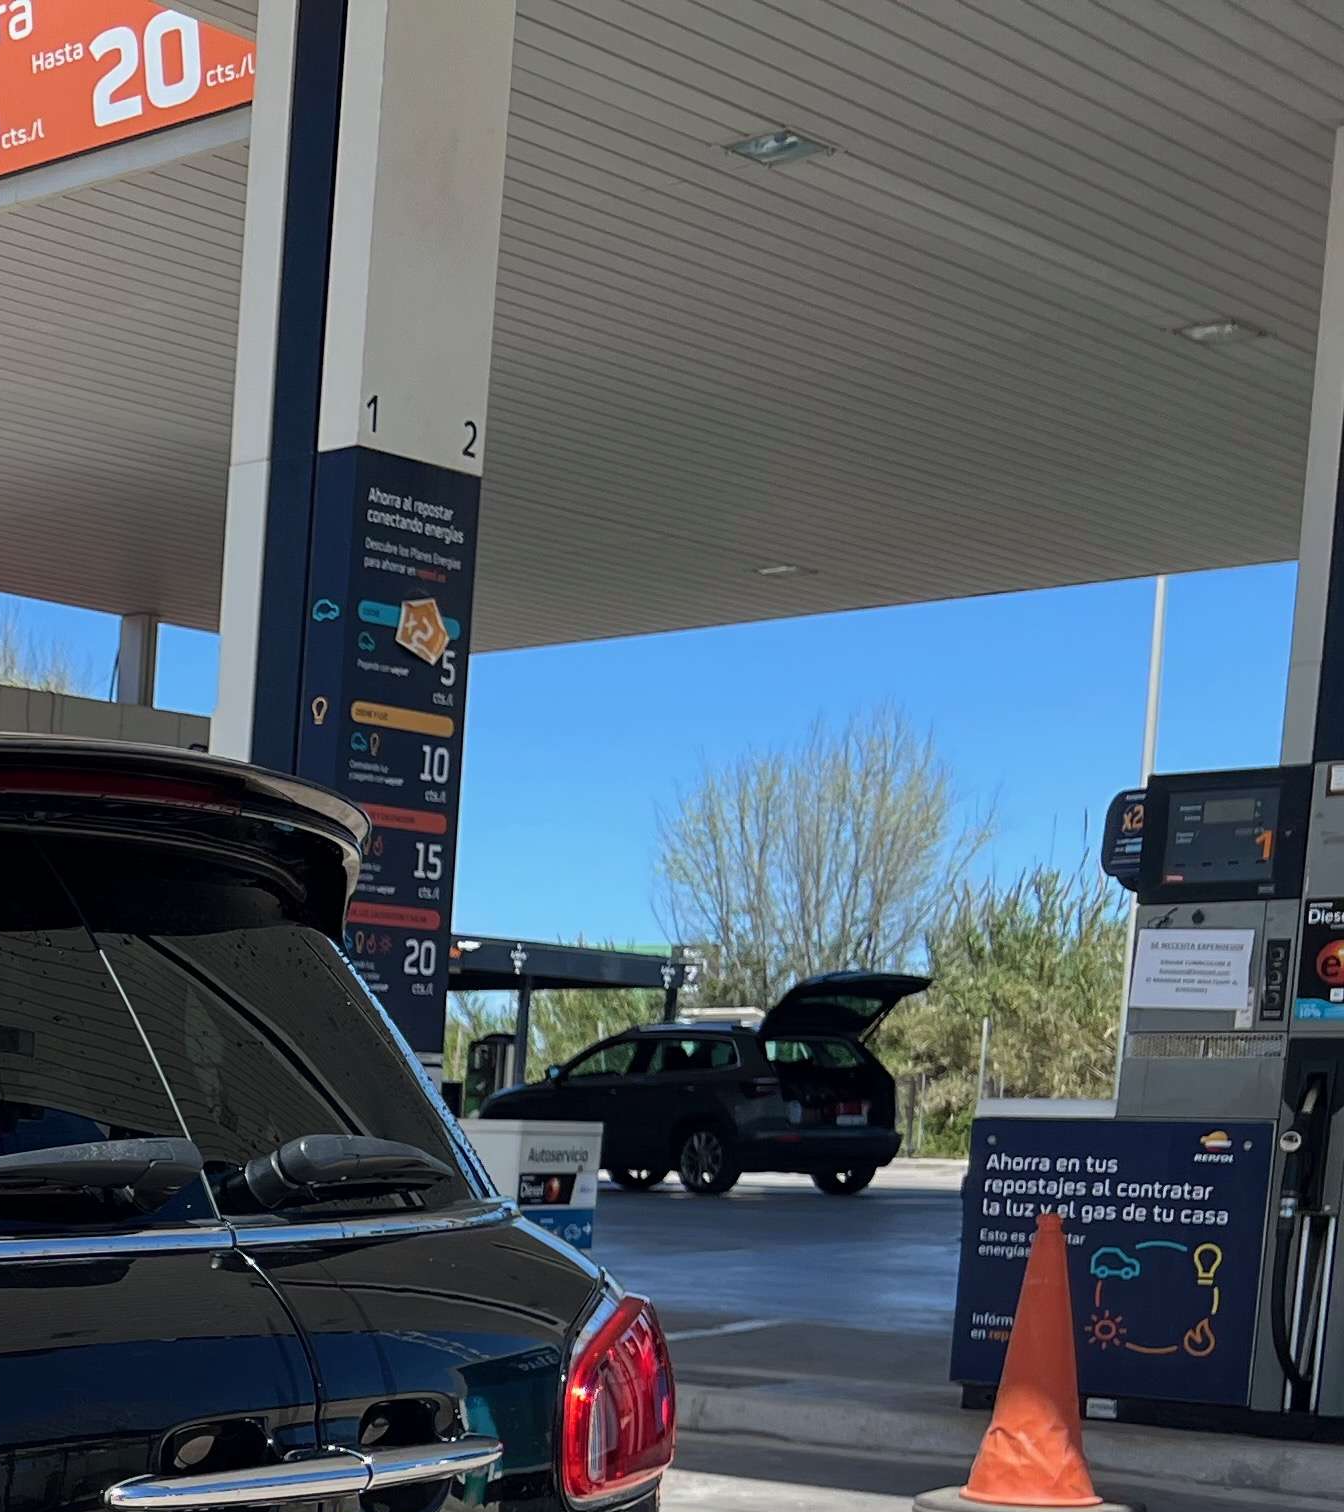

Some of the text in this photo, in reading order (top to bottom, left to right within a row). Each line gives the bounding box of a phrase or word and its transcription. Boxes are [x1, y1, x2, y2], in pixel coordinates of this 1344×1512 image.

[31, 40, 84, 74] Hasta
[89, 9, 201, 129] 20
[366, 395, 379, 433] 1
[462, 421, 477, 459] 2
[368, 487, 454, 521] Ahorra al repostar
[367, 509, 423, 534] conectando
[440, 650, 456, 687] 5
[419, 744, 450, 784] 10
[1255, 830, 1274, 861] 1
[413, 842, 443, 881] 15
[403, 938, 436, 977] 20
[528, 1145, 589, 1163] Autoservicio
[985, 1152, 1119, 1173] Ahorra en tus
[983, 1177, 1214, 1201] repostajes al contratar
[982, 1198, 1001, 1217] la
[1006, 1198, 1034, 1218] luz
[1057, 1201, 1076, 1219] el
[1081, 1204, 1117, 1223] gas
[1122, 1203, 1148, 1222] de
[1153, 1204, 1174, 1223] tu
[1180, 1207, 1229, 1226] casa
[979, 1227, 1008, 1242] Esto
[1010, 1232, 1026, 1243] es
[970, 1328, 987, 1340] en
[972, 1311, 1014, 1327] Infórm
